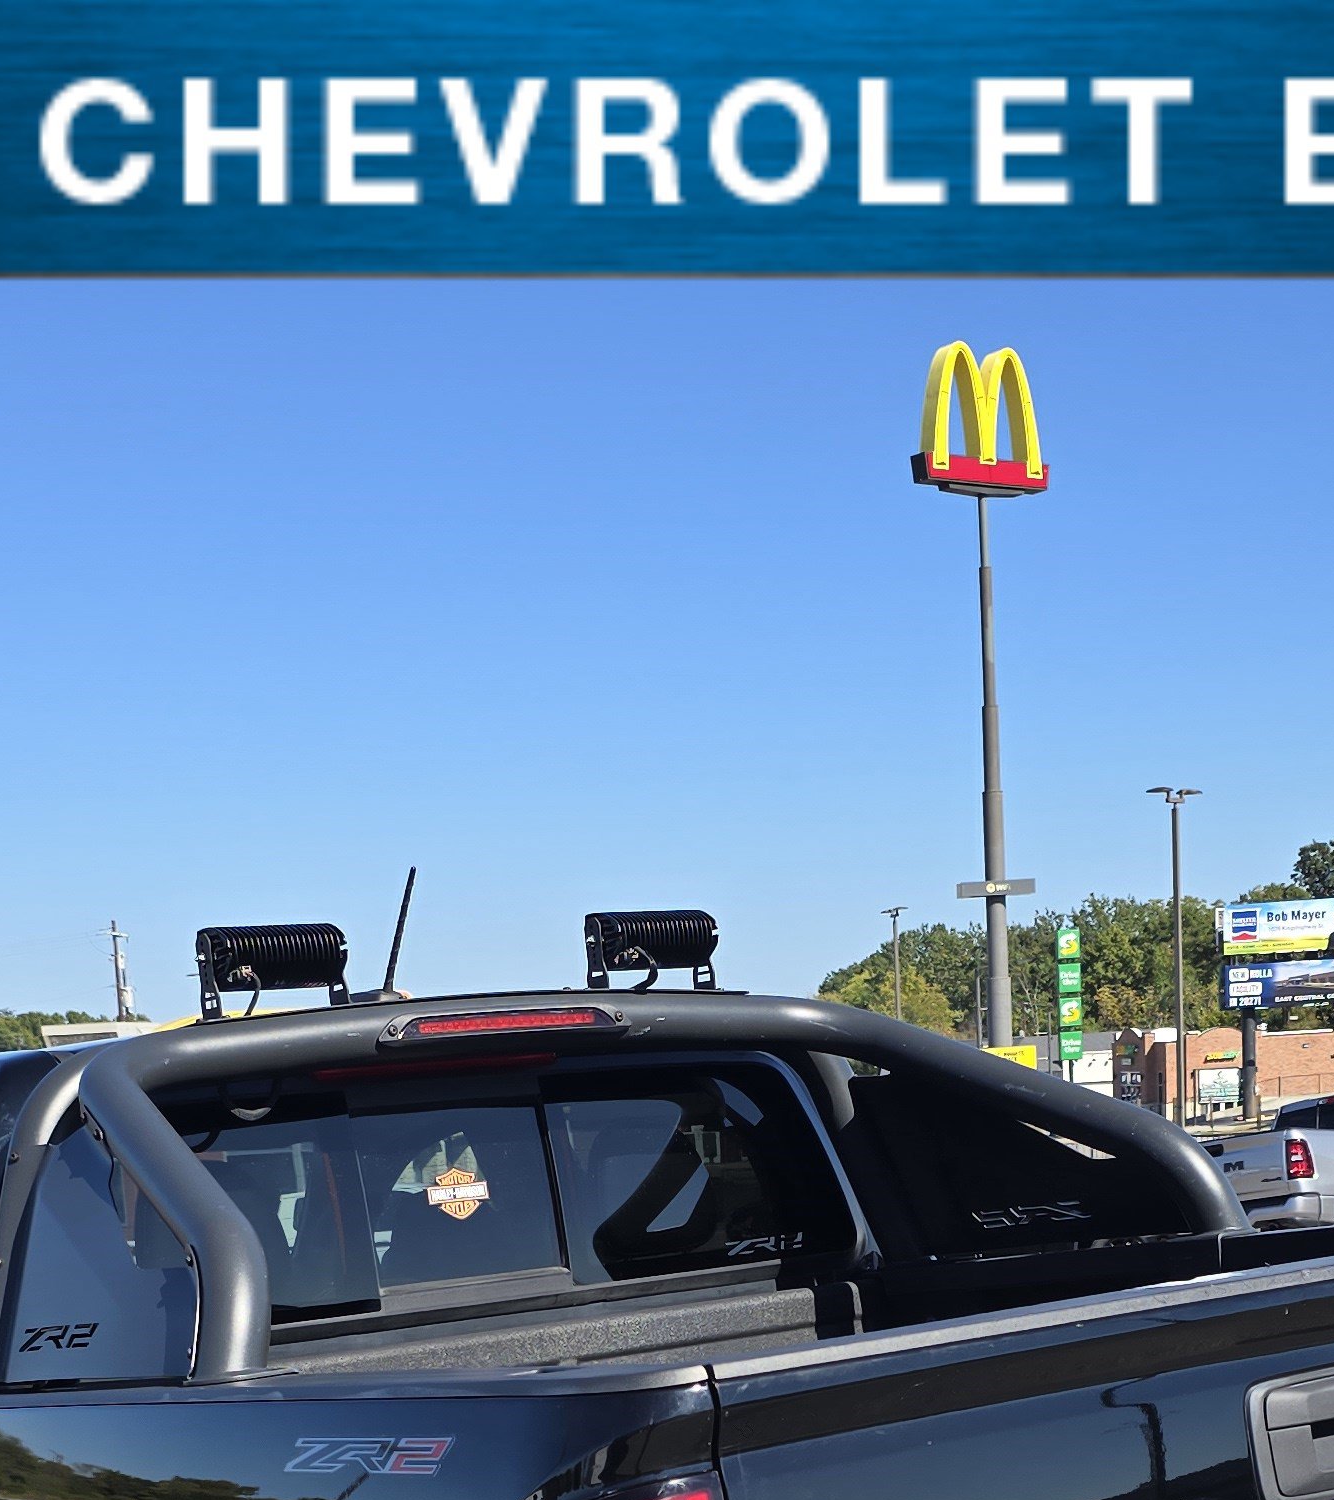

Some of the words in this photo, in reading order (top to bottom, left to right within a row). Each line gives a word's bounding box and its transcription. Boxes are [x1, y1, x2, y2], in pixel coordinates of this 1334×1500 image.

[1266, 911, 1288, 923] Bob
[1291, 909, 1327, 923] Mayer
[440, 1171, 472, 1186] MOTOR
[18, 1322, 100, 1353] ZR2
[283, 1437, 455, 1478] ZR2
